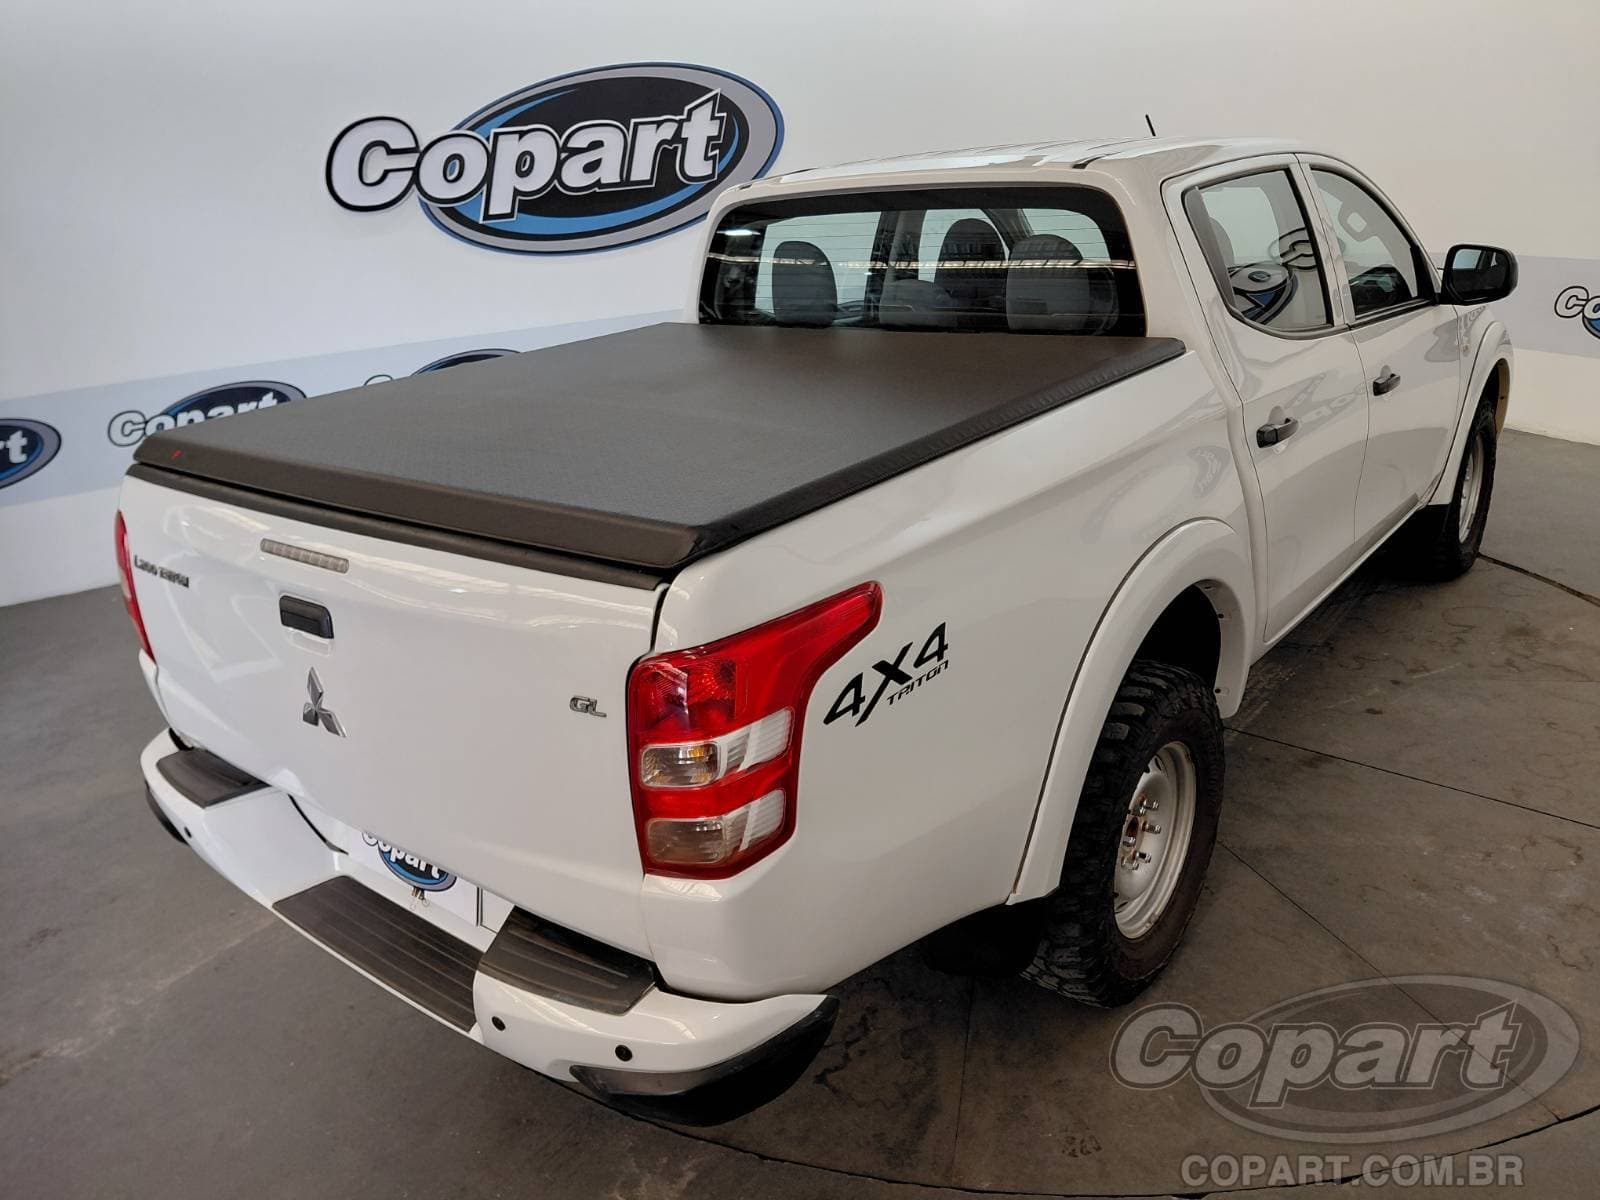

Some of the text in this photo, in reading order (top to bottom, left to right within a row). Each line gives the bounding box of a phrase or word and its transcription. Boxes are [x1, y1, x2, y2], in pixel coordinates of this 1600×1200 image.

[326, 88, 728, 224] Copart
[886, 659, 949, 706] TRITON
[569, 695, 607, 718] GL
